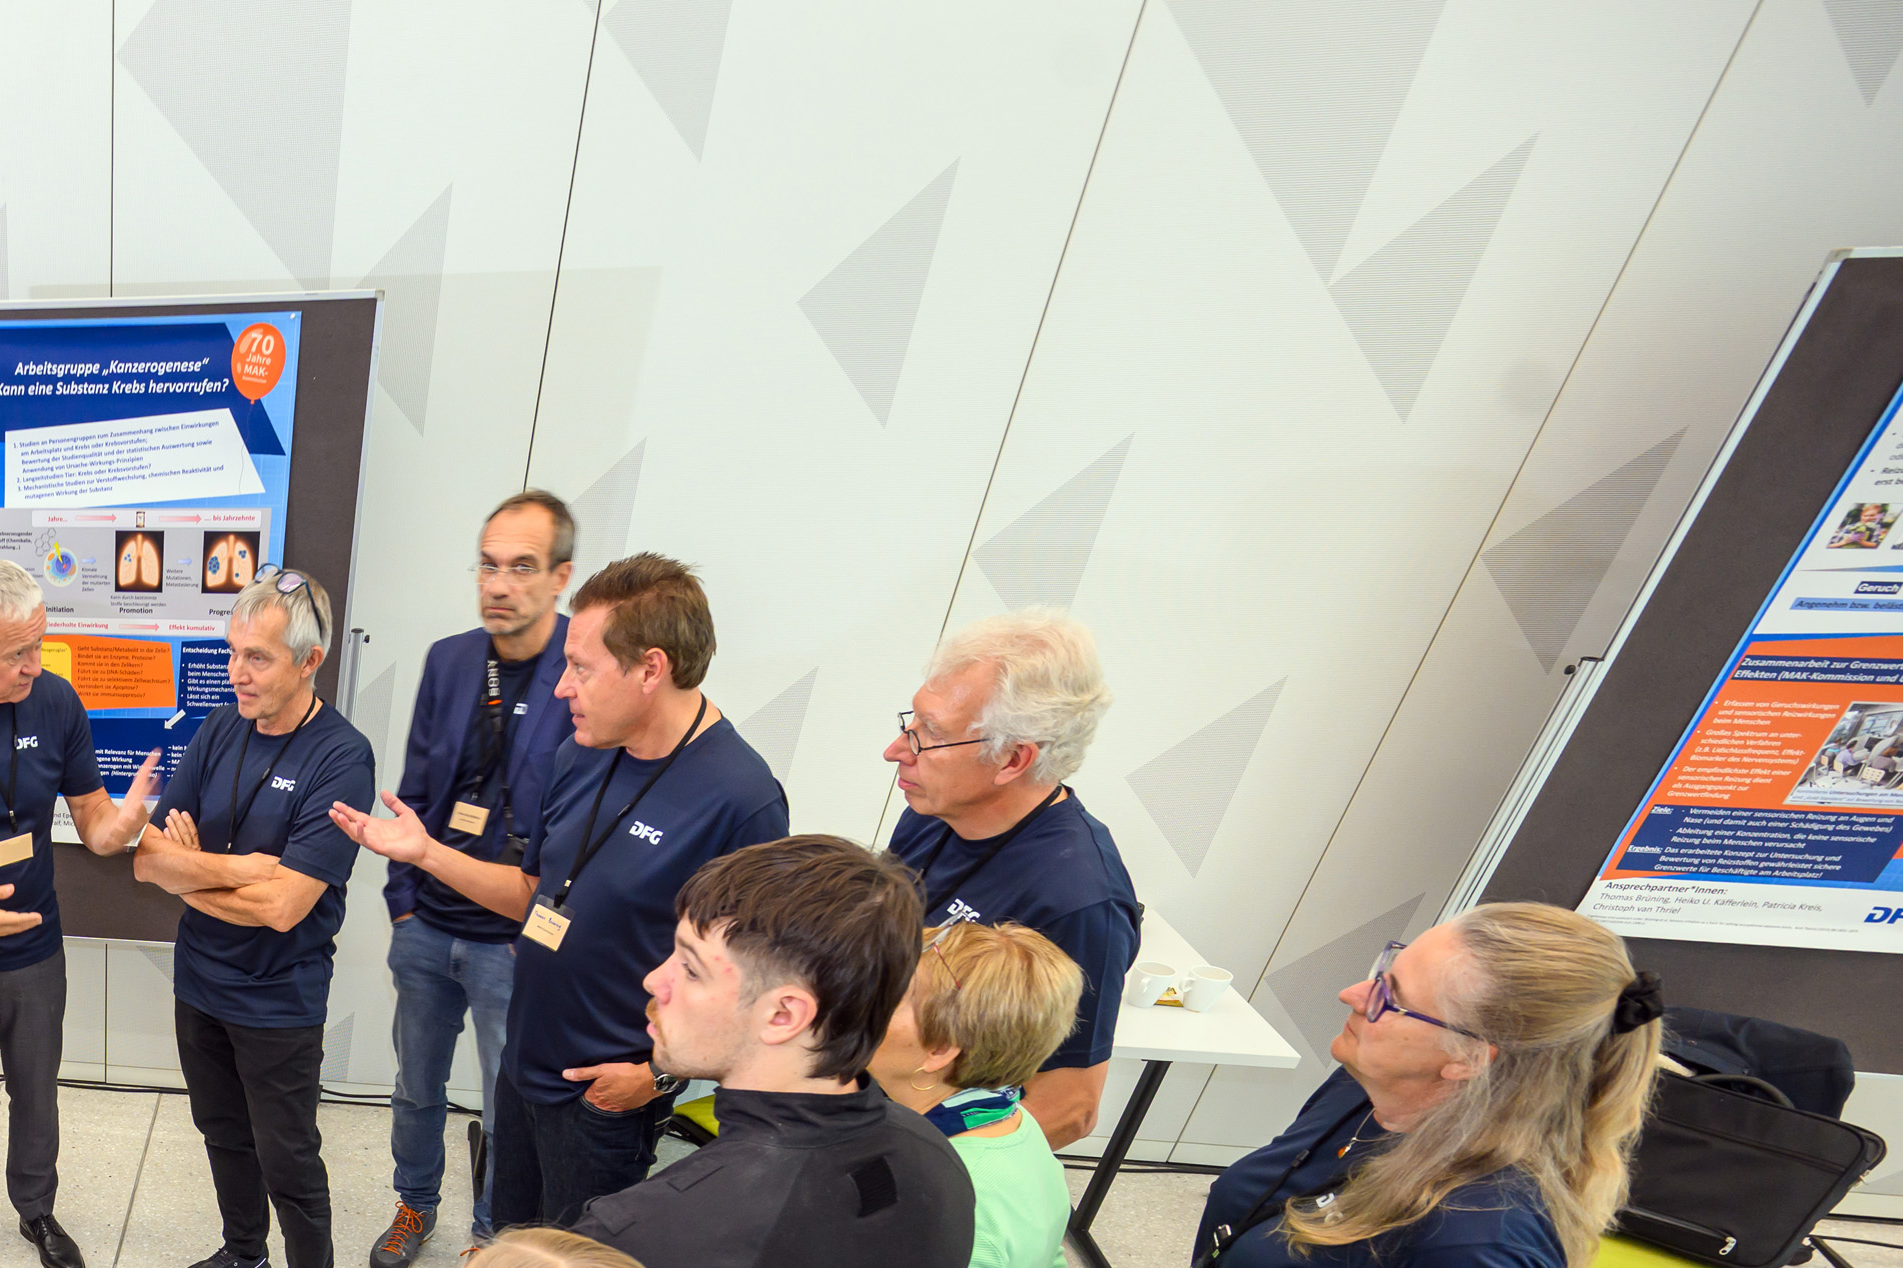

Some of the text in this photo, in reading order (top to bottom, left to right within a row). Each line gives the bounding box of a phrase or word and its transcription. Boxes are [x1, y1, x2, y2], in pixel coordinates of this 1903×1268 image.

[251, 333, 274, 355] 70
[246, 353, 271, 365] Jahre
[14, 358, 209, 378] Arbeitsgruppe „Kanzerogenese“
[244, 364, 268, 377] MAK-
[28, 381, 52, 395] eine
[56, 380, 109, 394] Substanz
[112, 379, 145, 393] Krebs
[148, 376, 229, 393] hervorrufen?
[19, 439, 40, 448] Studien
[49, 433, 96, 445] Personengruppen
[110, 428, 153, 438] Zusammenhang
[154, 425, 180, 434] zwischen
[181, 420, 219, 431] Einwirkungen
[30, 446, 62, 455] Arbeitsplatz
[63, 444, 74, 452] und
[75, 442, 90, 450] Krebs
[91, 440, 104, 448] oder
[1858, 583, 1900, 593] Geruch
[1796, 600, 1903, 610] Angenehm bzw. beläst
[183, 647, 217, 655] Entscheidung
[1741, 658, 1903, 670] Zusammenarbeit zur Grenzwert
[1734, 670, 1897, 682] Effekten (MAK-Kommission und
[17, 736, 38, 749] DFG
[271, 776, 296, 791] DFG
[1650, 806, 1674, 814] Ziele:
[1689, 807, 1730, 816] Vermeiden
[1732, 810, 1752, 818] einer
[1754, 811, 1805, 820] sensorischen
[1807, 813, 1837, 822] Reizung
[1850, 815, 1876, 824] Augen
[1703, 817, 1722, 825] (und
[1723, 818, 1747, 826] damit
[1790, 820, 1834, 831] Schädigung
[1852, 824, 1893, 833] Gewebes)
[629, 821, 664, 845] DFG
[1676, 827, 1714, 836] Ableitung
[1736, 830, 1791, 839] Konzentration,
[1831, 834, 1877, 843] sensorische
[1671, 836, 1701, 845] Reizung
[1724, 839, 1763, 847] Menschen
[1627, 844, 1663, 854] Ergebnis:
[1680, 847, 1722, 855] erarbeitete
[1723, 849, 1754, 858] Konzept
[1770, 852, 1823, 861] Untersuchung
[1659, 855, 1700, 864] Bewertung
[1716, 857, 1759, 866] Reizstoffen
[1759, 860, 1811, 870] gewährleistet
[1811, 862, 1842, 870] sichere
[1654, 864, 1697, 872] Grenzwerte
[1711, 866, 1758, 876] Beschäftigte
[1773, 869, 1824, 878] Arbeitsplatz!
[1593, 903, 1681, 915] Christoph van Thriel
[1599, 893, 1634, 902] Thomas
[1635, 894, 1672, 904] Brüning,
[1674, 896, 1701, 905] Heiko
[1702, 898, 1711, 906] U.
[1761, 901, 1797, 911] Patricia
[1799, 903, 1823, 912] Kreis,
[1864, 907, 1903, 924] DF
